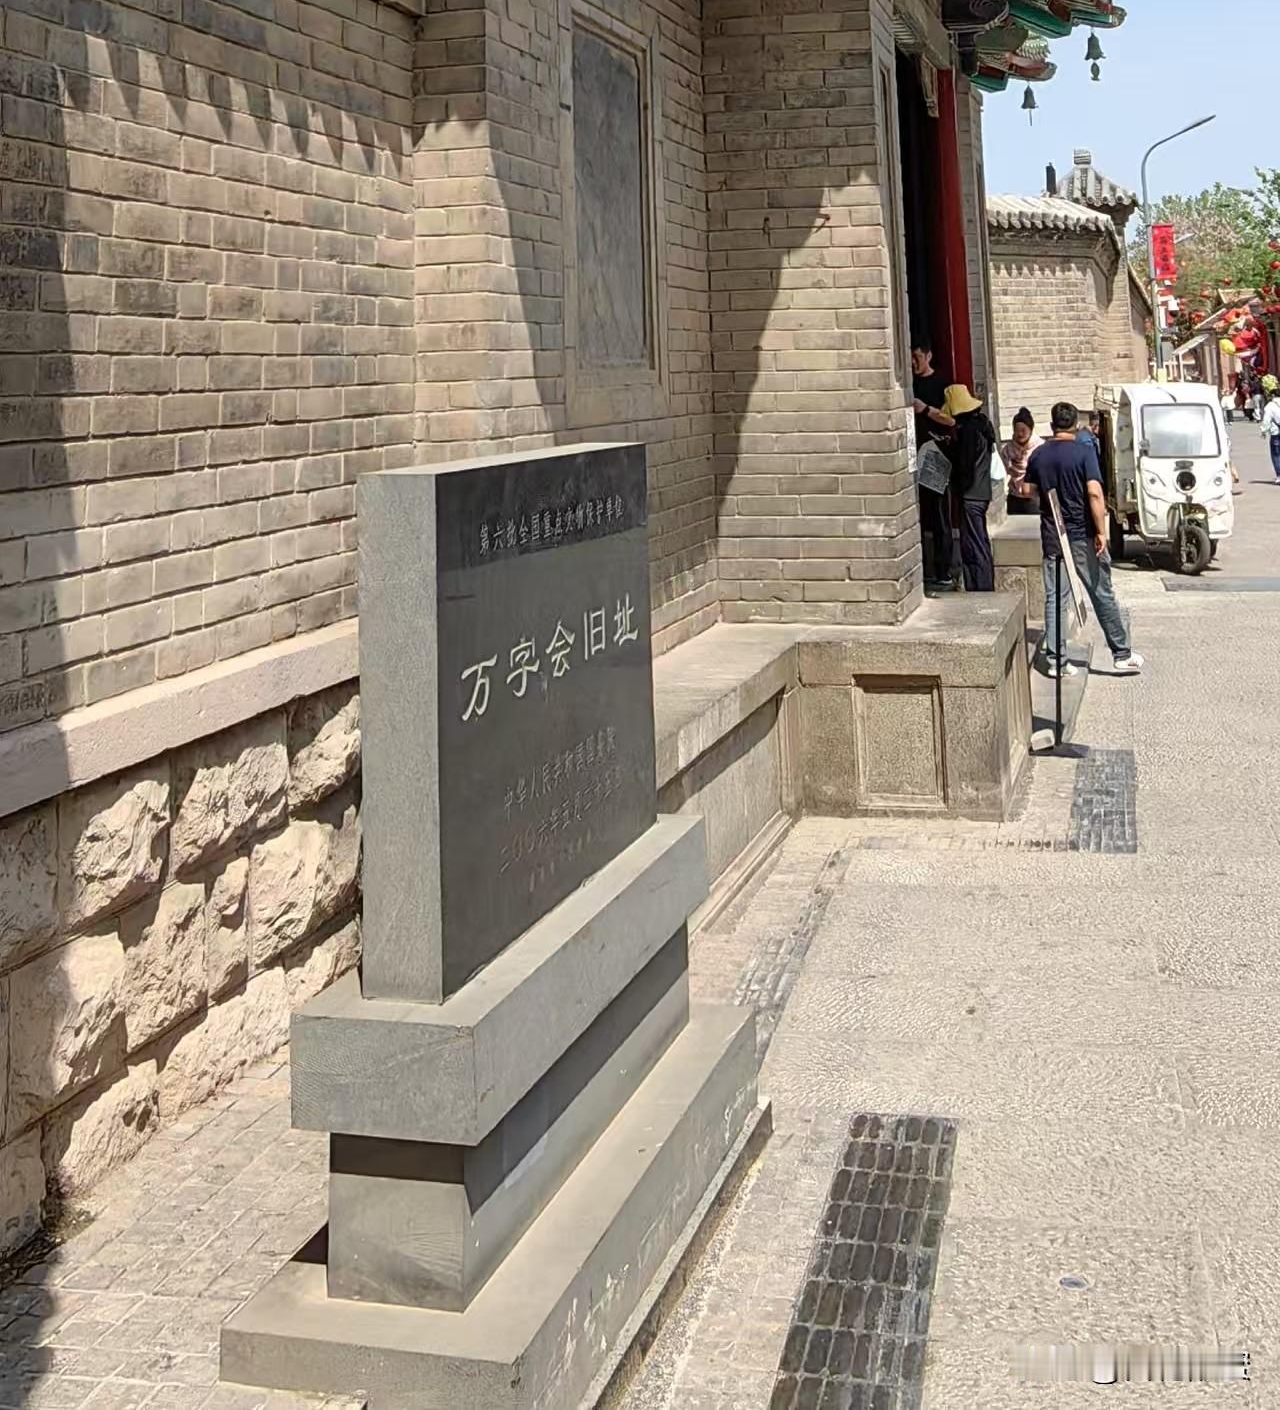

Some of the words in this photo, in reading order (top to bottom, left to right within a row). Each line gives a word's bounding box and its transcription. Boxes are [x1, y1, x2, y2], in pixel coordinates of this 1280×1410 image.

[480, 494, 624, 556] 第六批全国重点文物保护单位
[461, 591, 638, 721] 万字会旧址
